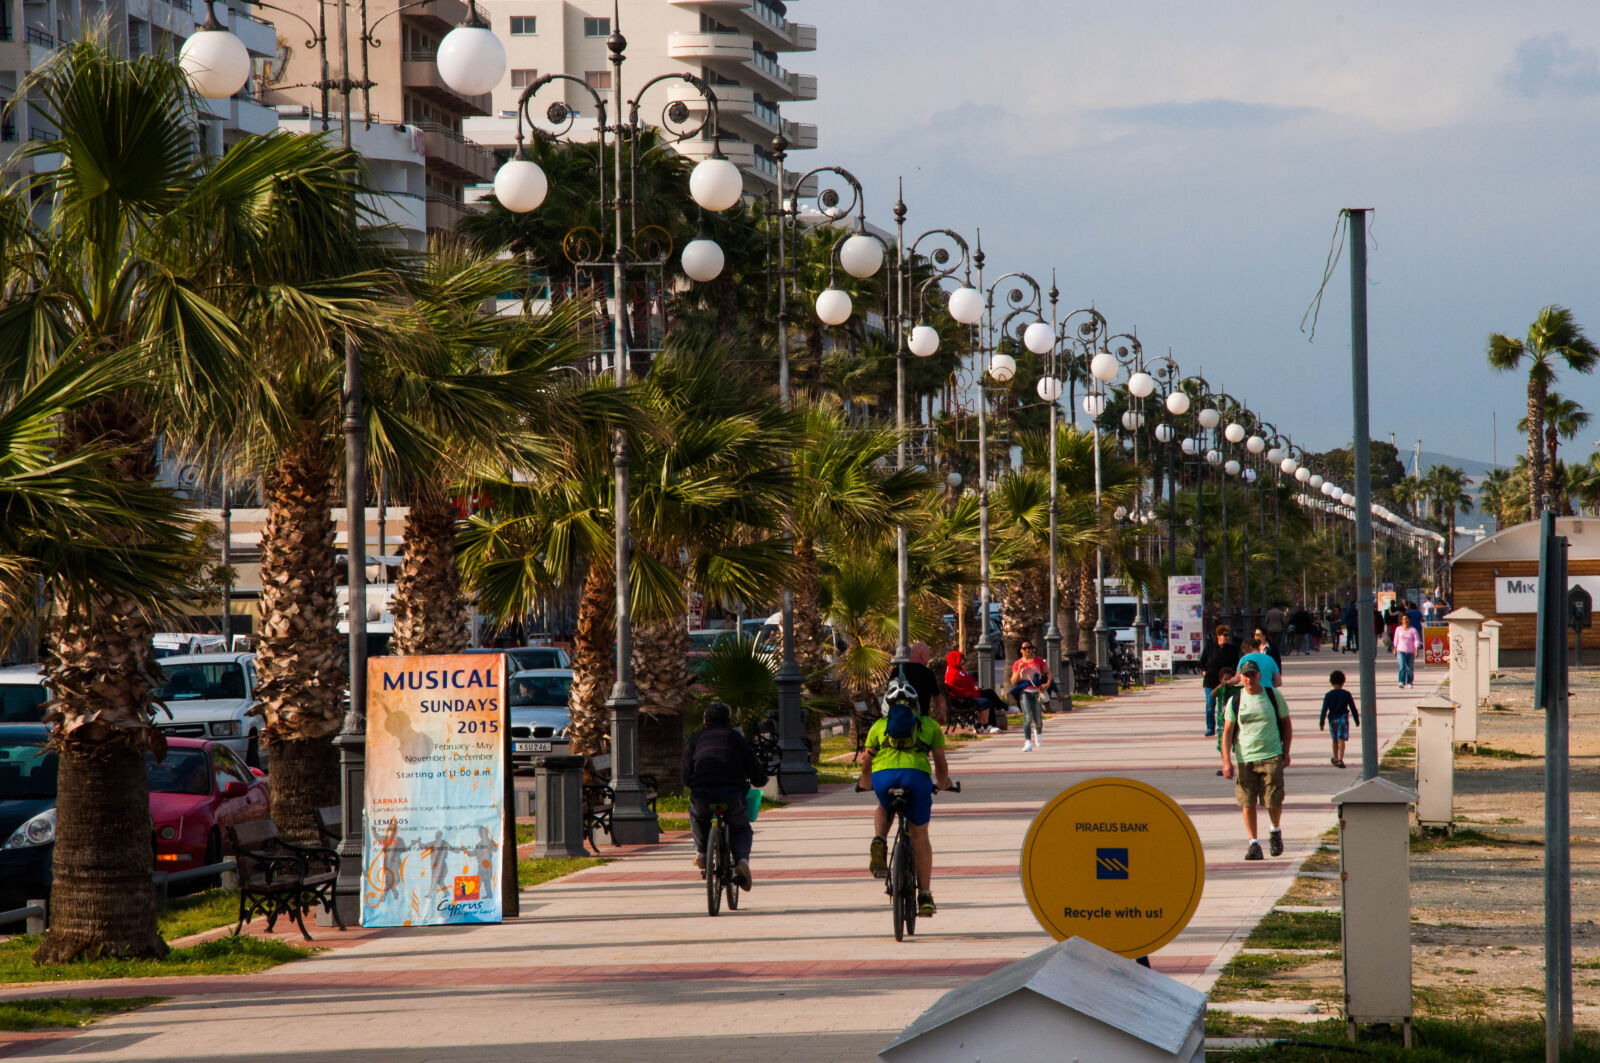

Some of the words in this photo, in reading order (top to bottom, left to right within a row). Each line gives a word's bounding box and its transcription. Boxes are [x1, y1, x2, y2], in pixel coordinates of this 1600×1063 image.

[383, 669, 498, 691] MUSICAL
[420, 698, 498, 713] SUNDAYS
[457, 720, 499, 734] 2015
[434, 742, 469, 754] February
[476, 742, 494, 751] May
[405, 754, 447, 763] November
[453, 753, 493, 762] December
[396, 770, 434, 779] Starting
[449, 769, 472, 777] 11:00
[373, 797, 408, 805] LARNAKA
[1075, 822, 1118, 832] PIRAEUS
[1120, 822, 1149, 832] BANK
[437, 899, 484, 917] Cyprus
[1064, 907, 1111, 920] Recycle
[1115, 907, 1142, 918] with
[1145, 907, 1163, 918] us!
